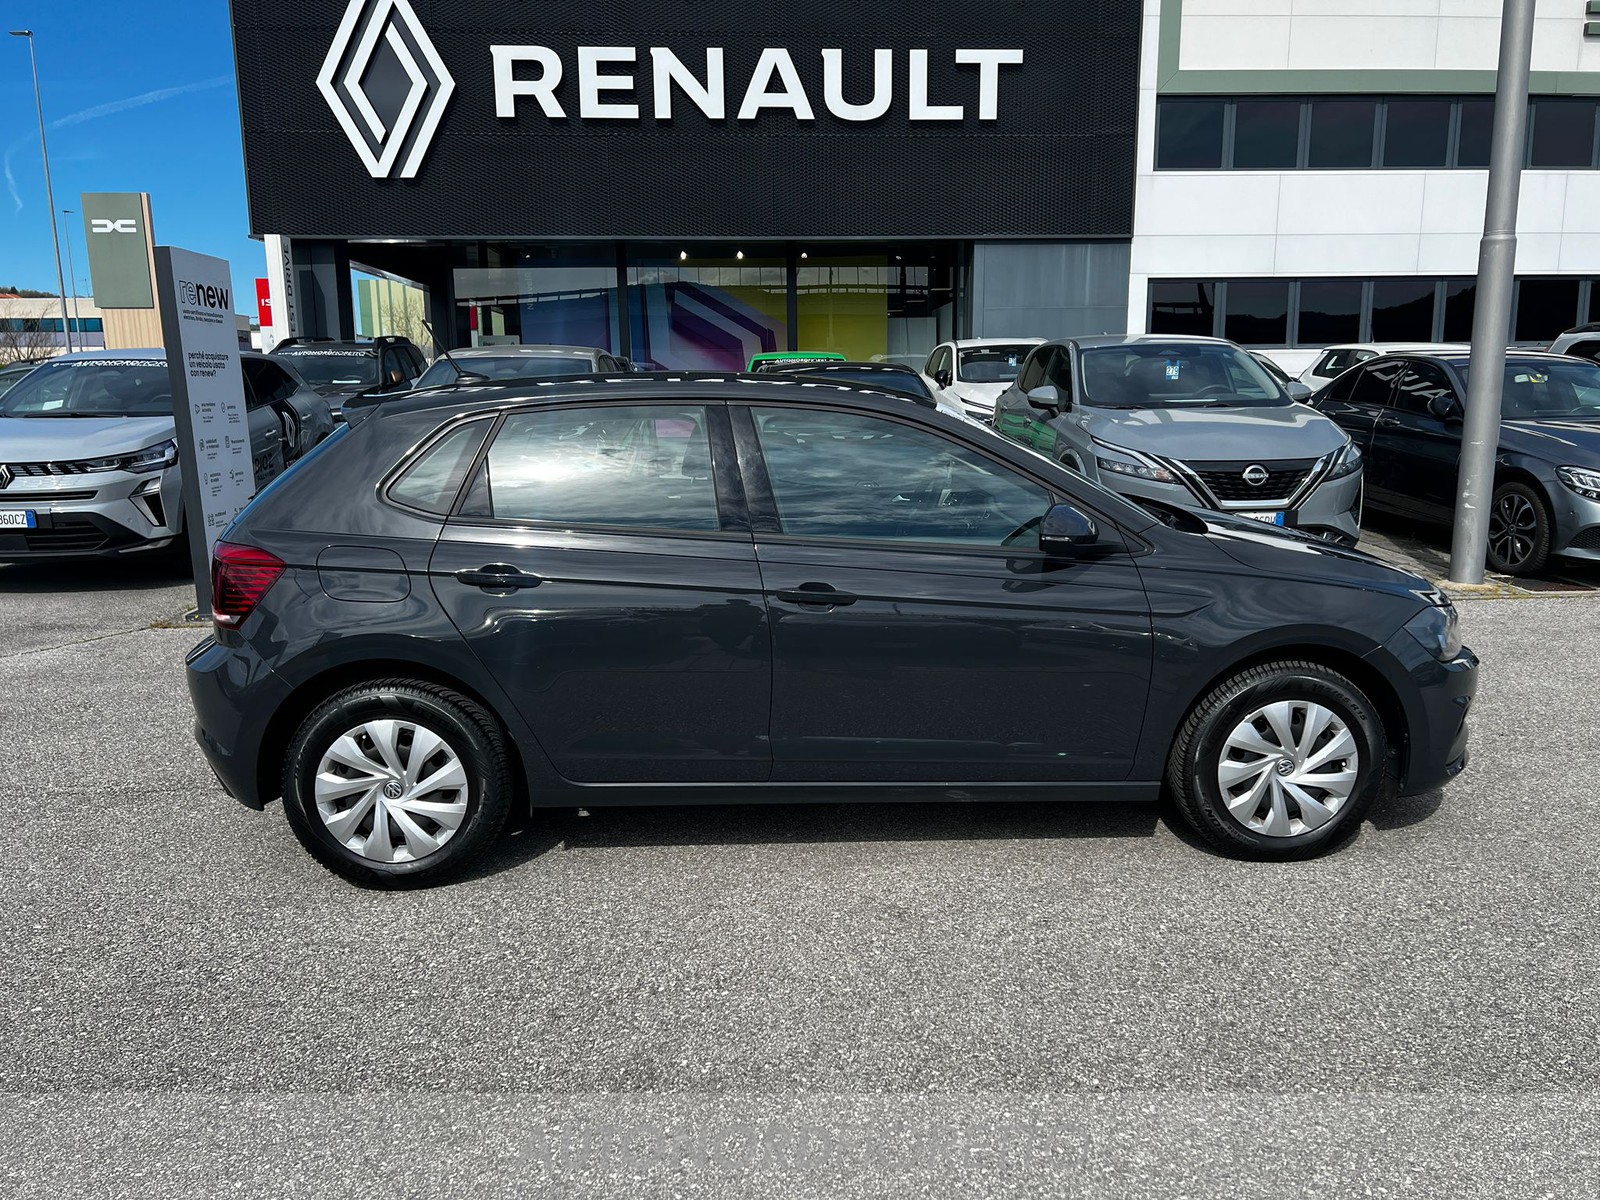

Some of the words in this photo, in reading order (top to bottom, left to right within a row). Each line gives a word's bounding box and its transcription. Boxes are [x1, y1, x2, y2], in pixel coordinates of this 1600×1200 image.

[490, 45, 1024, 121] RENAULT
[282, 244, 294, 297] DRIVE
[178, 279, 229, 310] renew
[188, 351, 205, 361] perché
[205, 352, 229, 361] acquistare
[196, 360, 213, 369] veicolo
[213, 361, 226, 369] usato
[190, 369, 200, 377] con
[200, 369, 217, 377] renew?
